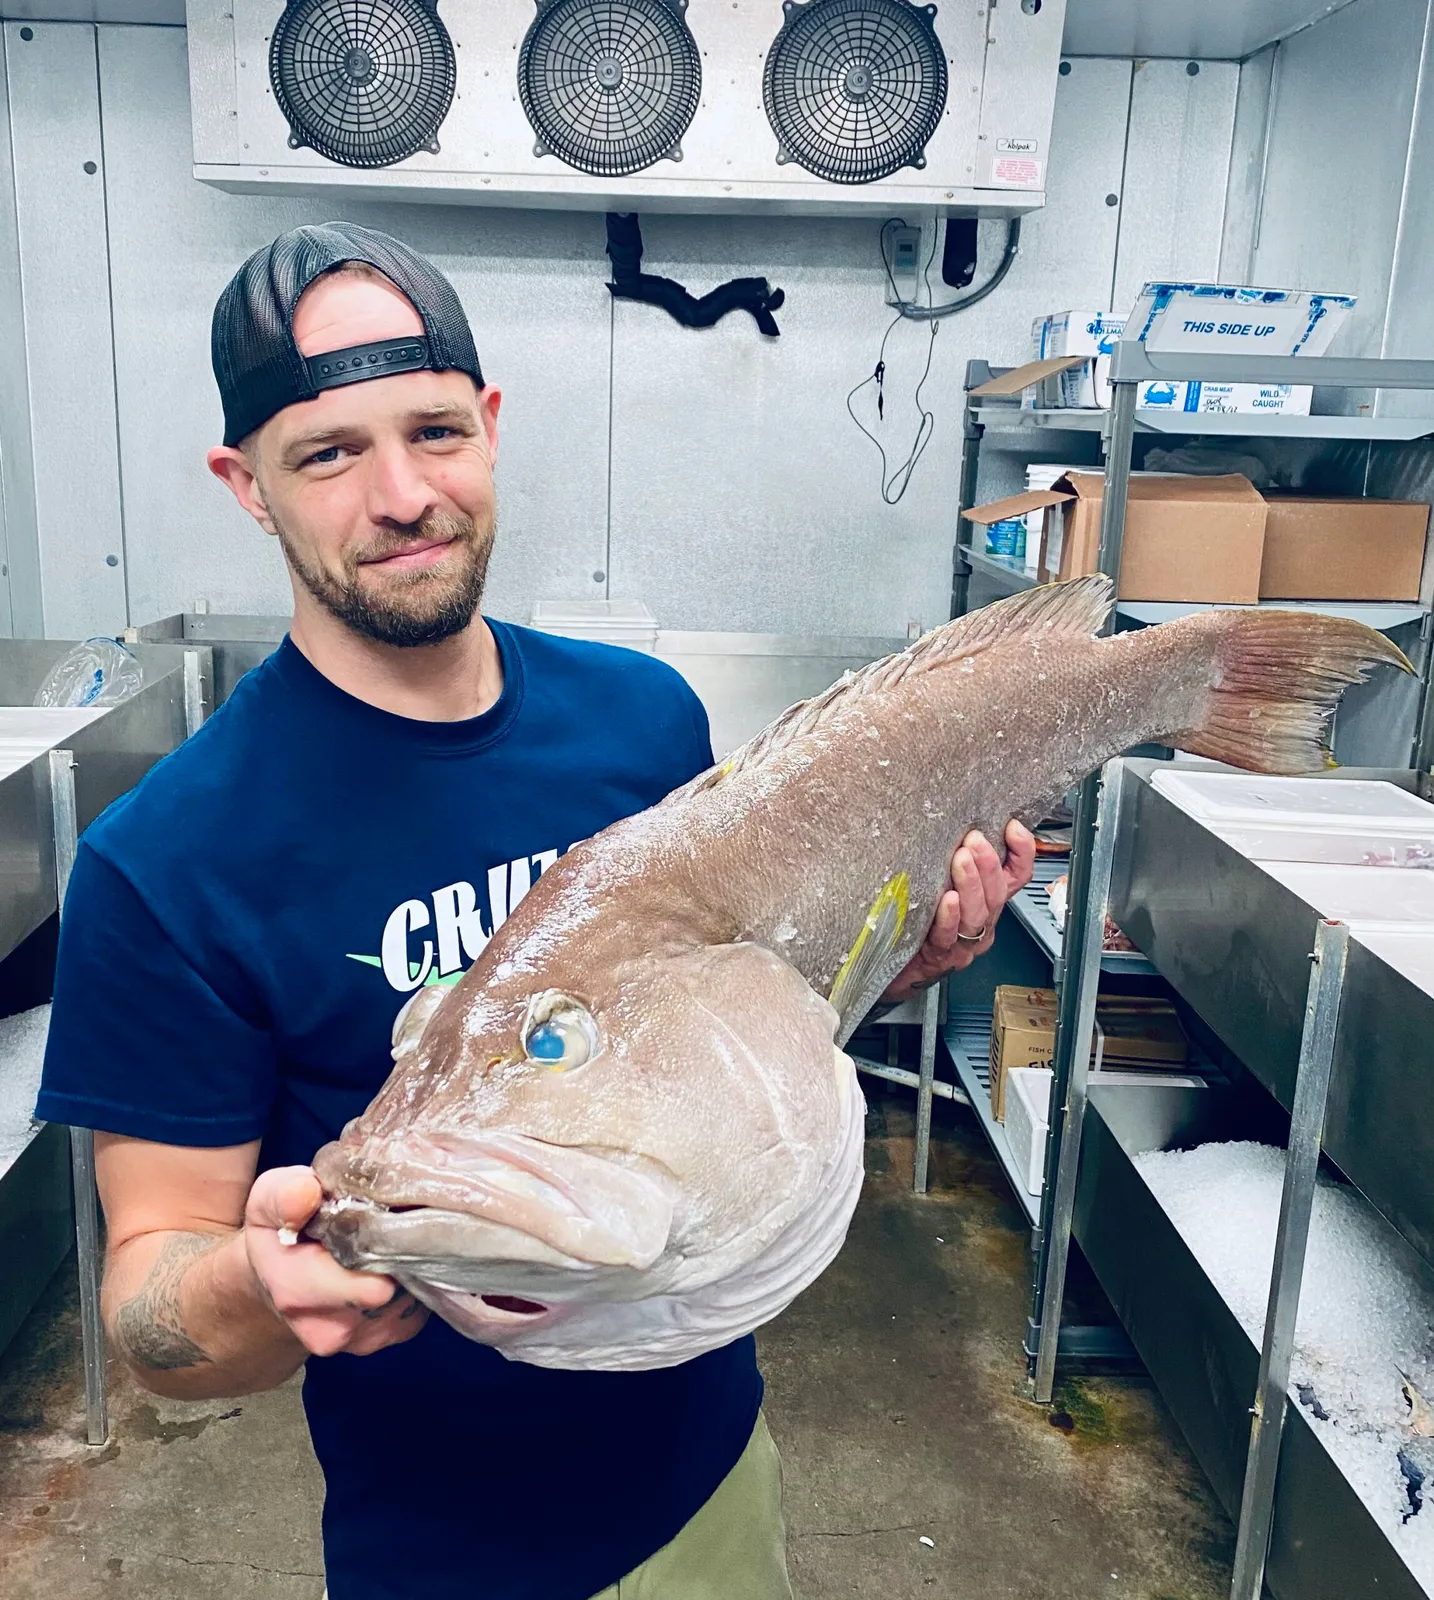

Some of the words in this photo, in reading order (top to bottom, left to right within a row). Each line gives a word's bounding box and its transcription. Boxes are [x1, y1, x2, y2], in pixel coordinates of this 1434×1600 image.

[1184, 321, 1215, 333] THIS
[1218, 323, 1252, 336] SIDE
[1254, 326, 1275, 336] UP
[1260, 389, 1279, 398] WILD
[1252, 400, 1284, 409] CAUGHT
